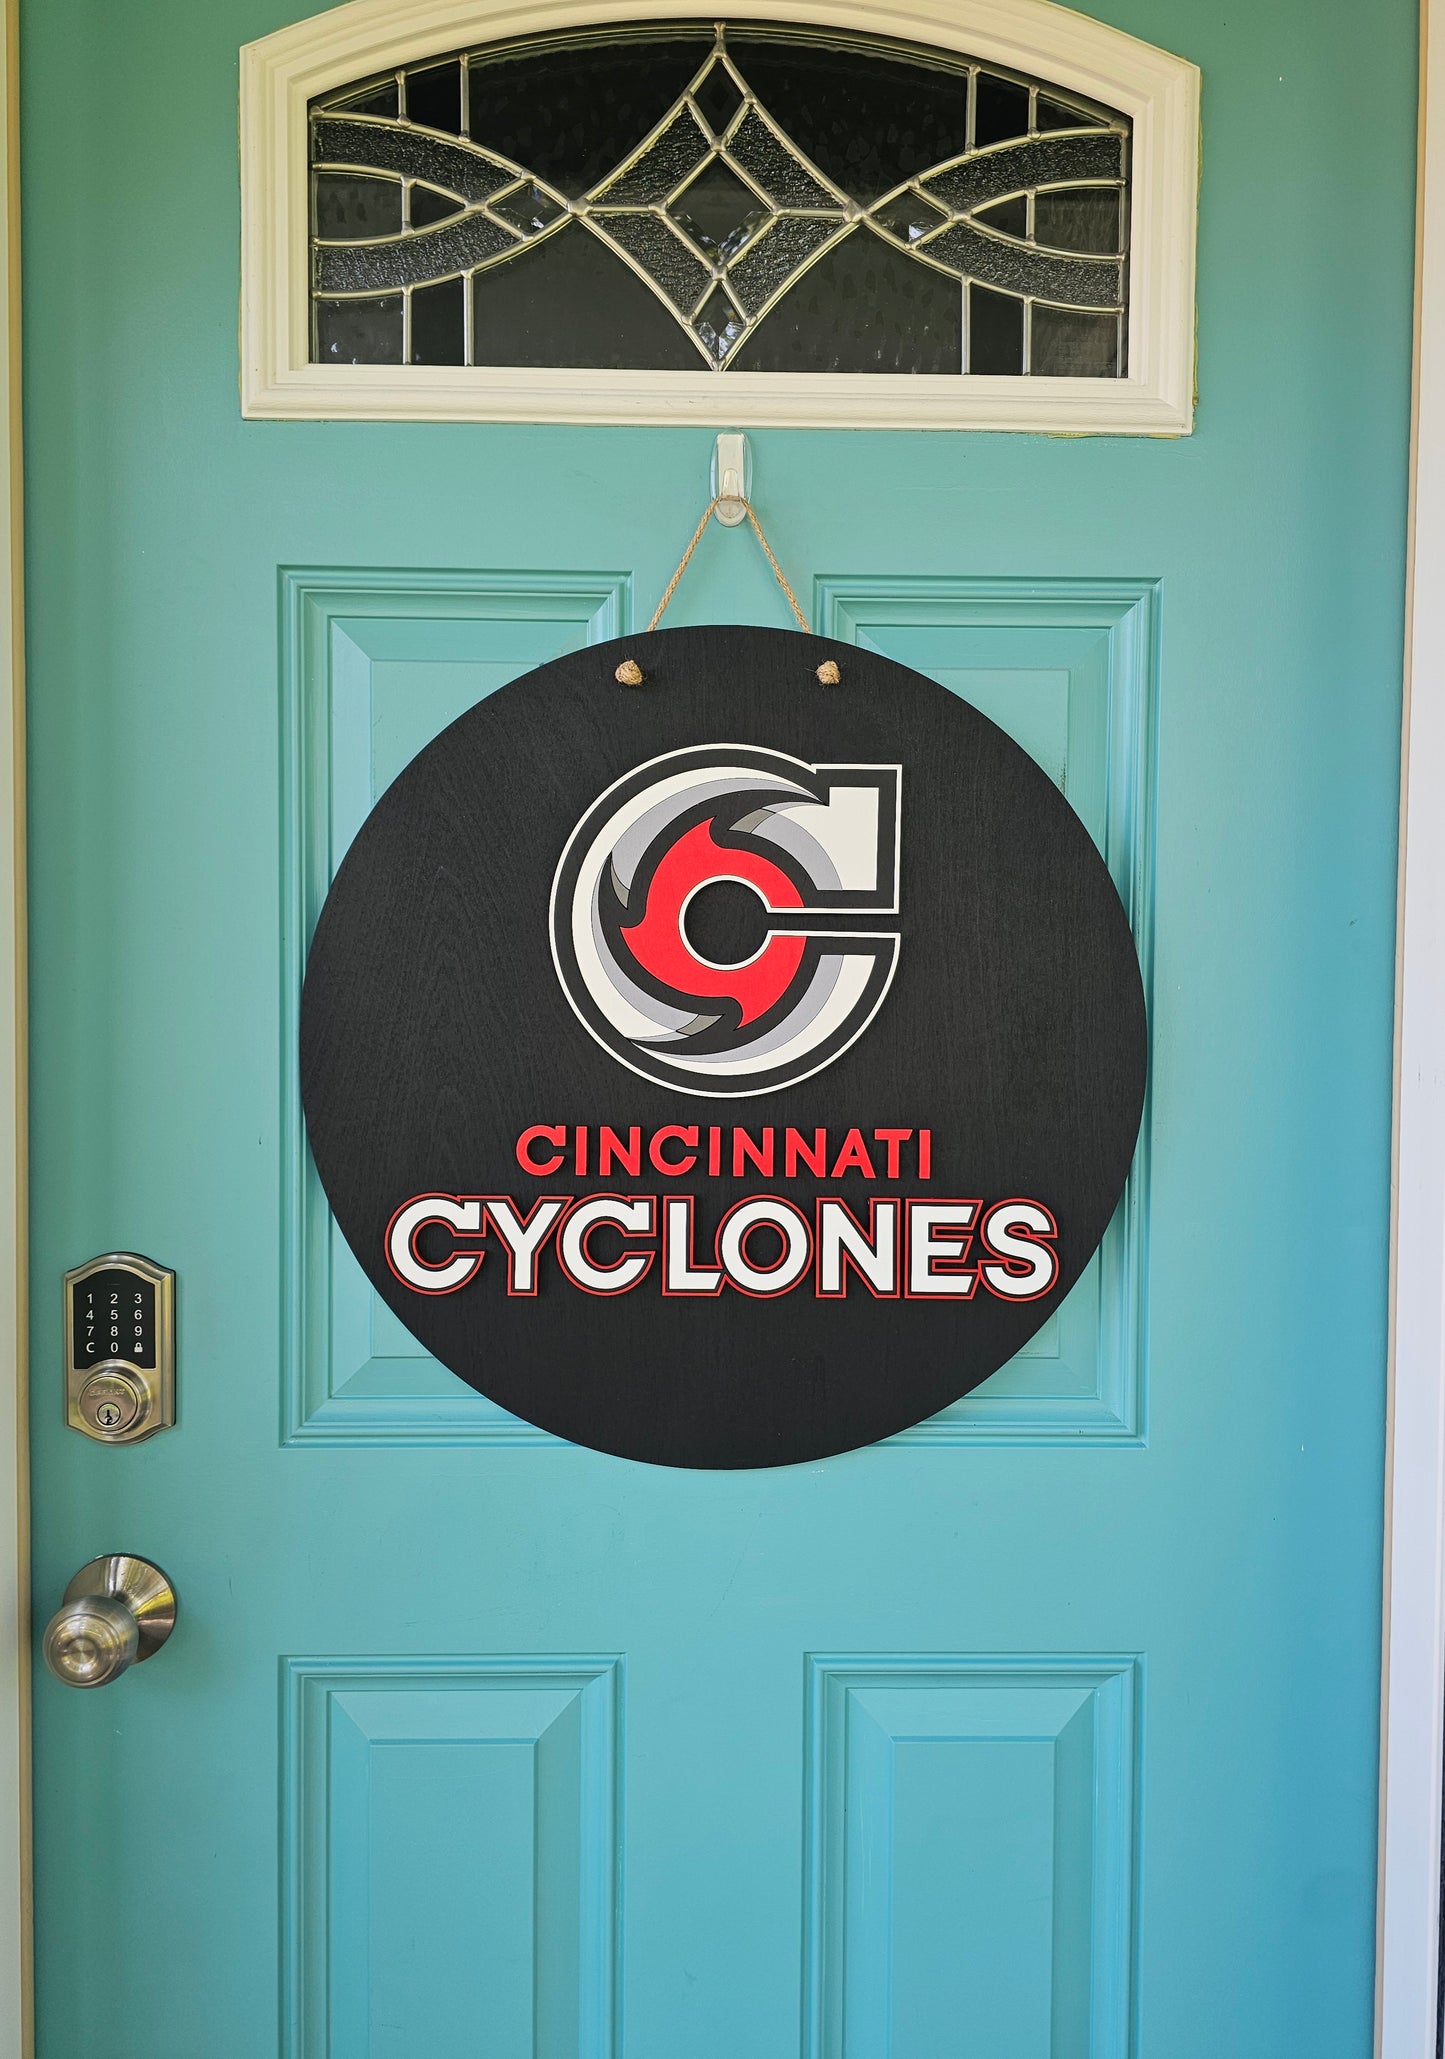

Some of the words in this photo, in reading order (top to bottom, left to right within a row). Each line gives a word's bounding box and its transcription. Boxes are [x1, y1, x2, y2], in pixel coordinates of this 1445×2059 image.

[516, 1125, 931, 1179] CINCINNATI
[385, 1193, 1059, 1301] CYCLONES
[86, 1293, 93, 1304] 1
[110, 1293, 118, 1304] 2
[134, 1293, 142, 1304] 3
[86, 1309, 94, 1320] 4
[110, 1309, 118, 1320] 5
[134, 1309, 142, 1320] 6
[86, 1325, 94, 1337] 7
[110, 1325, 118, 1337] 8
[134, 1325, 142, 1337] 9
[86, 1342, 95, 1353] C
[110, 1342, 118, 1353] 0
